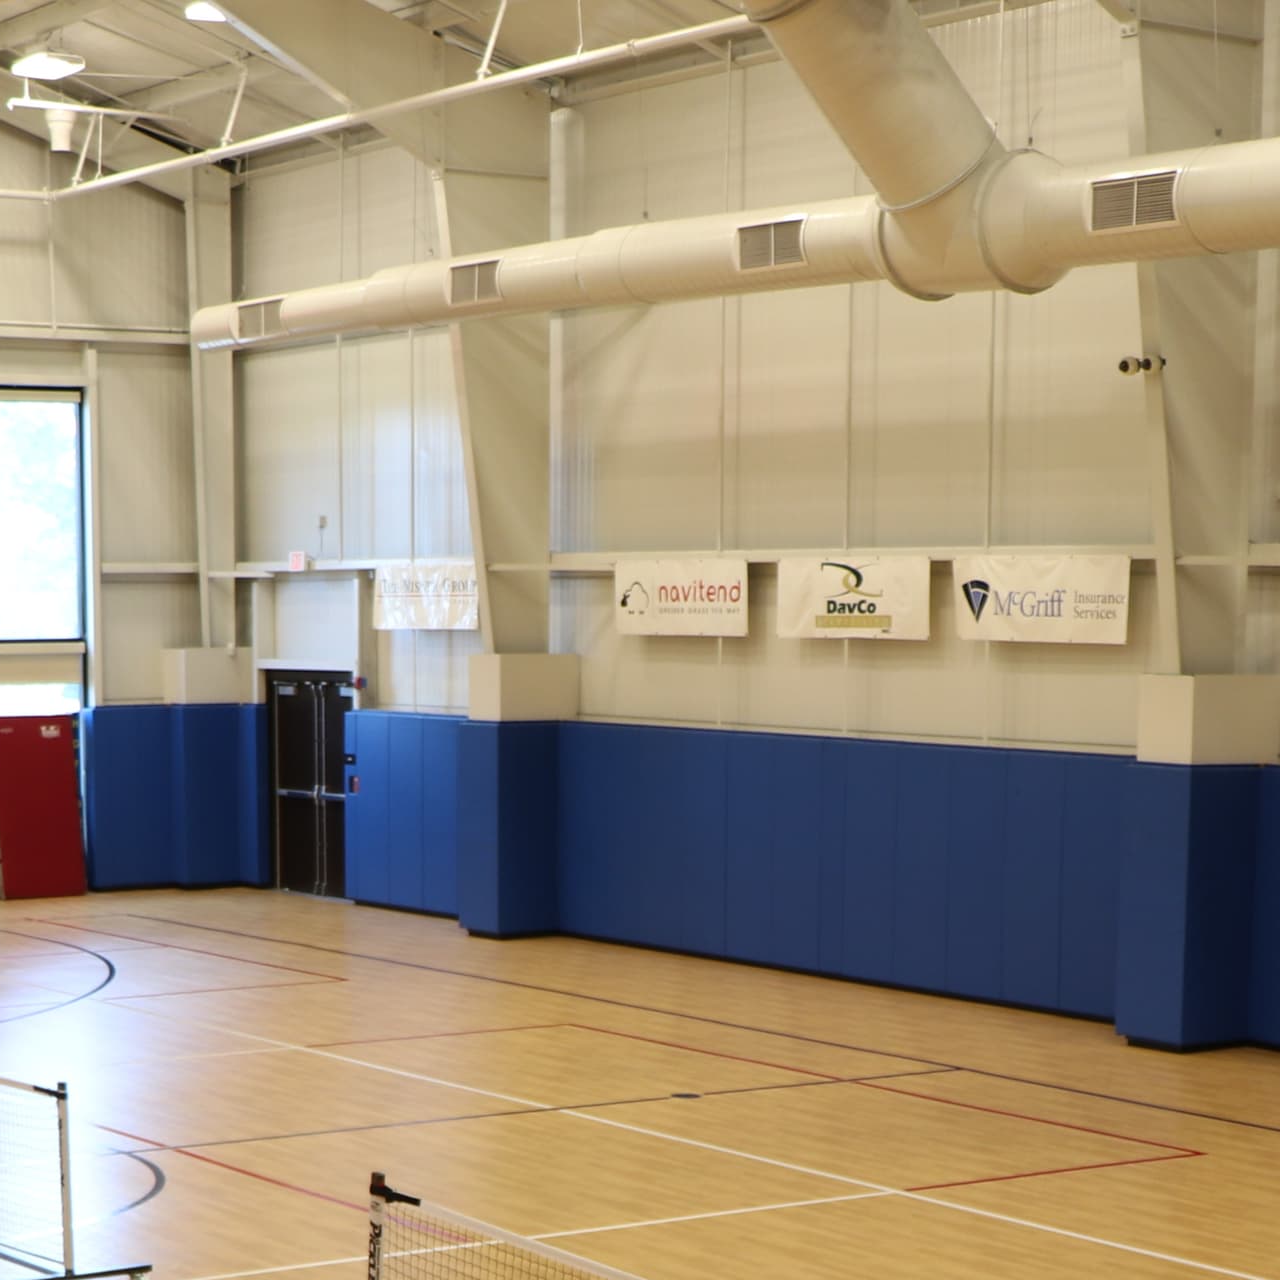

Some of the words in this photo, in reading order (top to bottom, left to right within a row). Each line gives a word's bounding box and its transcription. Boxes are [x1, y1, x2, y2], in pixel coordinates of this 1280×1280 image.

[658, 580, 741, 603] navitend
[827, 600, 876, 615] DavCo
[993, 589, 1066, 618] McGriff
[1073, 605, 1117, 620] Services
